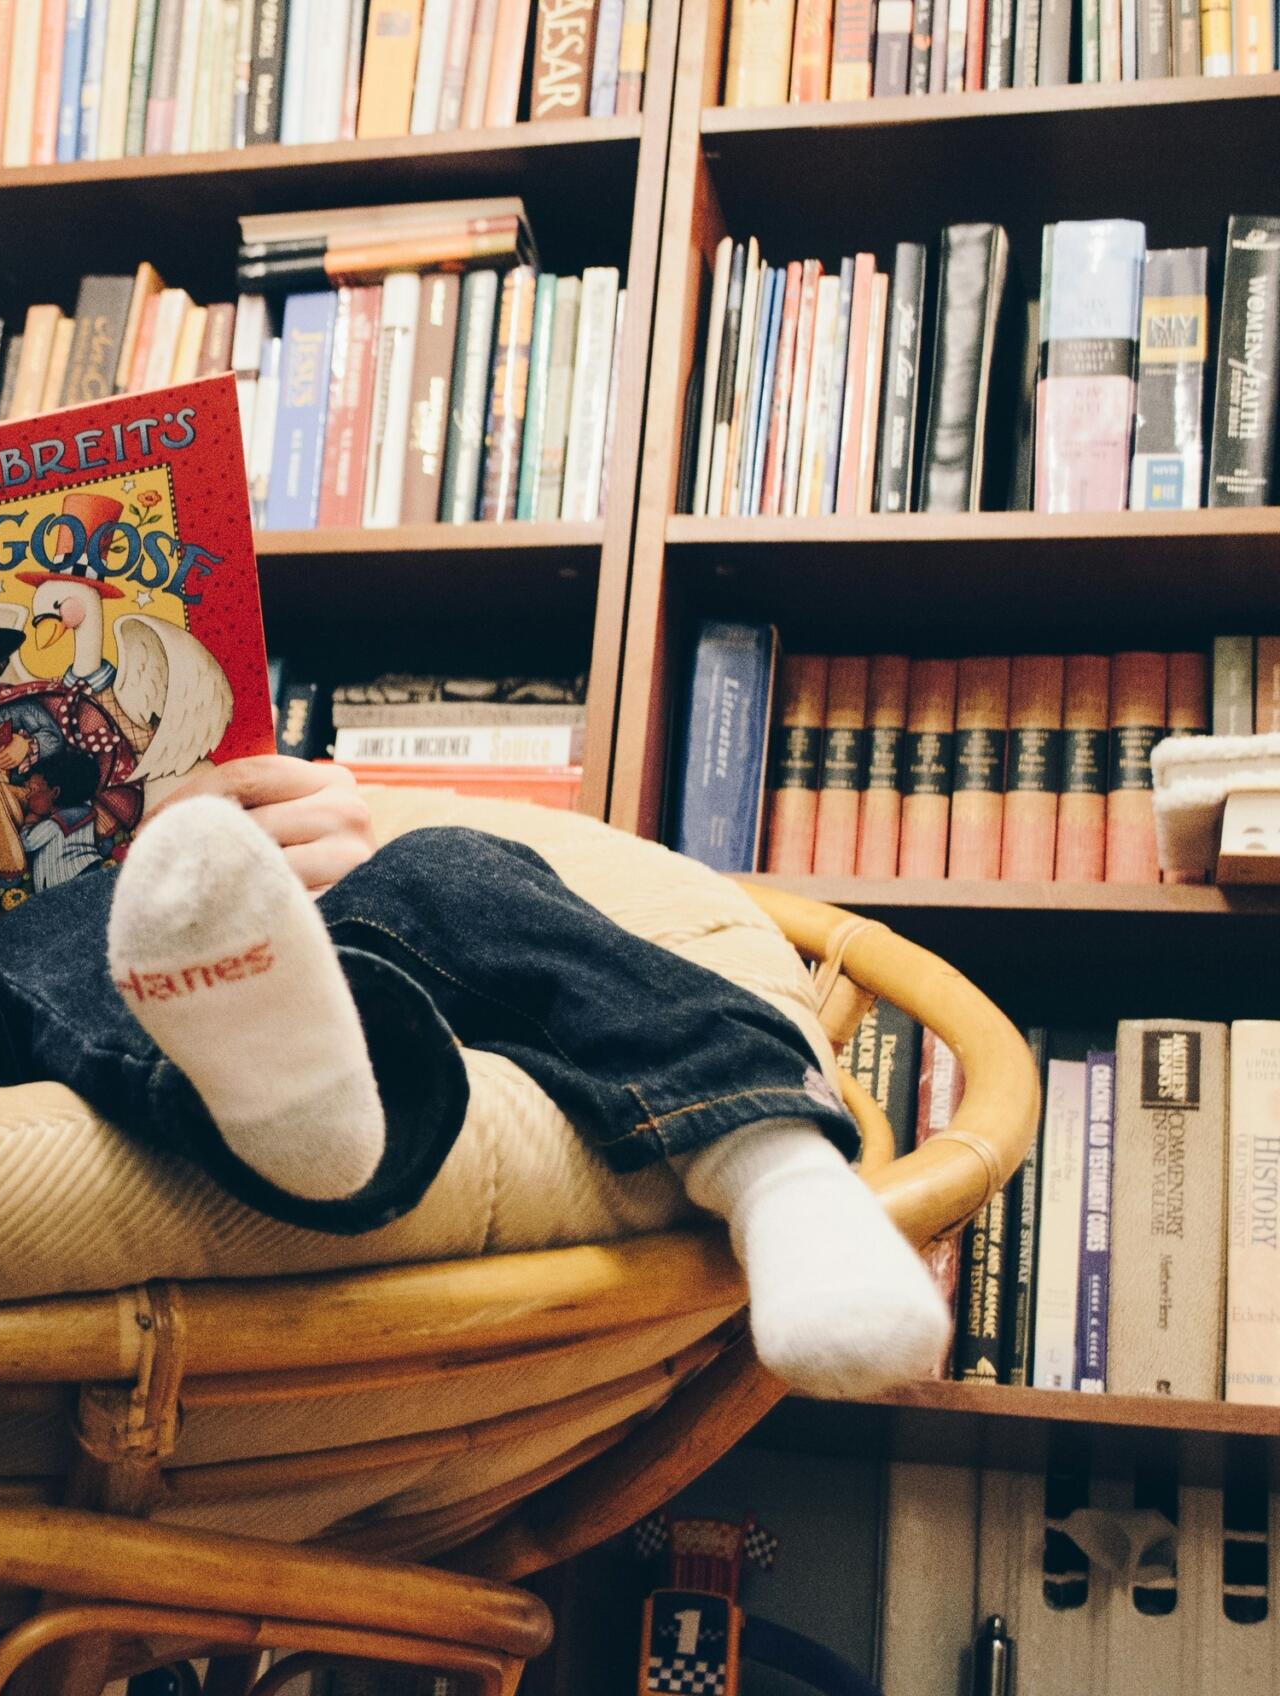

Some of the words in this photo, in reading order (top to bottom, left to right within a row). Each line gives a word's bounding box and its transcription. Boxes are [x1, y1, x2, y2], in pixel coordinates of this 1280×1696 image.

[536, 0, 591, 118] AESAR
[1244, 275, 1267, 360] WOMEN
[1239, 377, 1263, 440] FAITH
[354, 736, 395, 759] JAMES
[413, 734, 472, 758] MICHENER
[717, 675, 739, 778] Literature
[877, 1034, 897, 1111] Dictionary
[1089, 1062, 1113, 1121] CRACKING
[1171, 1032, 1189, 1102] MATTHEW
[1089, 1123, 1112, 1147] OLD
[1152, 1132, 1167, 1166] ONE
[1153, 1110, 1168, 1131] IN
[1234, 1133, 1248, 1164] OLD
[1019, 1168, 1036, 1227] HEBREW
[1086, 1147, 1111, 1214] TESTAMENT
[1151, 1169, 1167, 1236] VOLUME
[1166, 1110, 1186, 1240] COMMENTARY
[1251, 1135, 1278, 1250] HISTORY
[1085, 1213, 1109, 1253] CODES
[1233, 1165, 1248, 1248] TESTAMENT
[970, 1234, 986, 1260] OLD
[985, 1246, 1003, 1275] AND
[1017, 1229, 1034, 1285] SYNTAX
[1158, 1253, 1173, 1298] Matthew
[967, 1264, 984, 1338] TESTAMENT
[981, 1276, 1001, 1339] ARAMAIC
[1157, 1298, 1172, 1331] Henry
[1232, 1305, 1280, 1324] Edersh
[674, 1609, 703, 1655] 1
